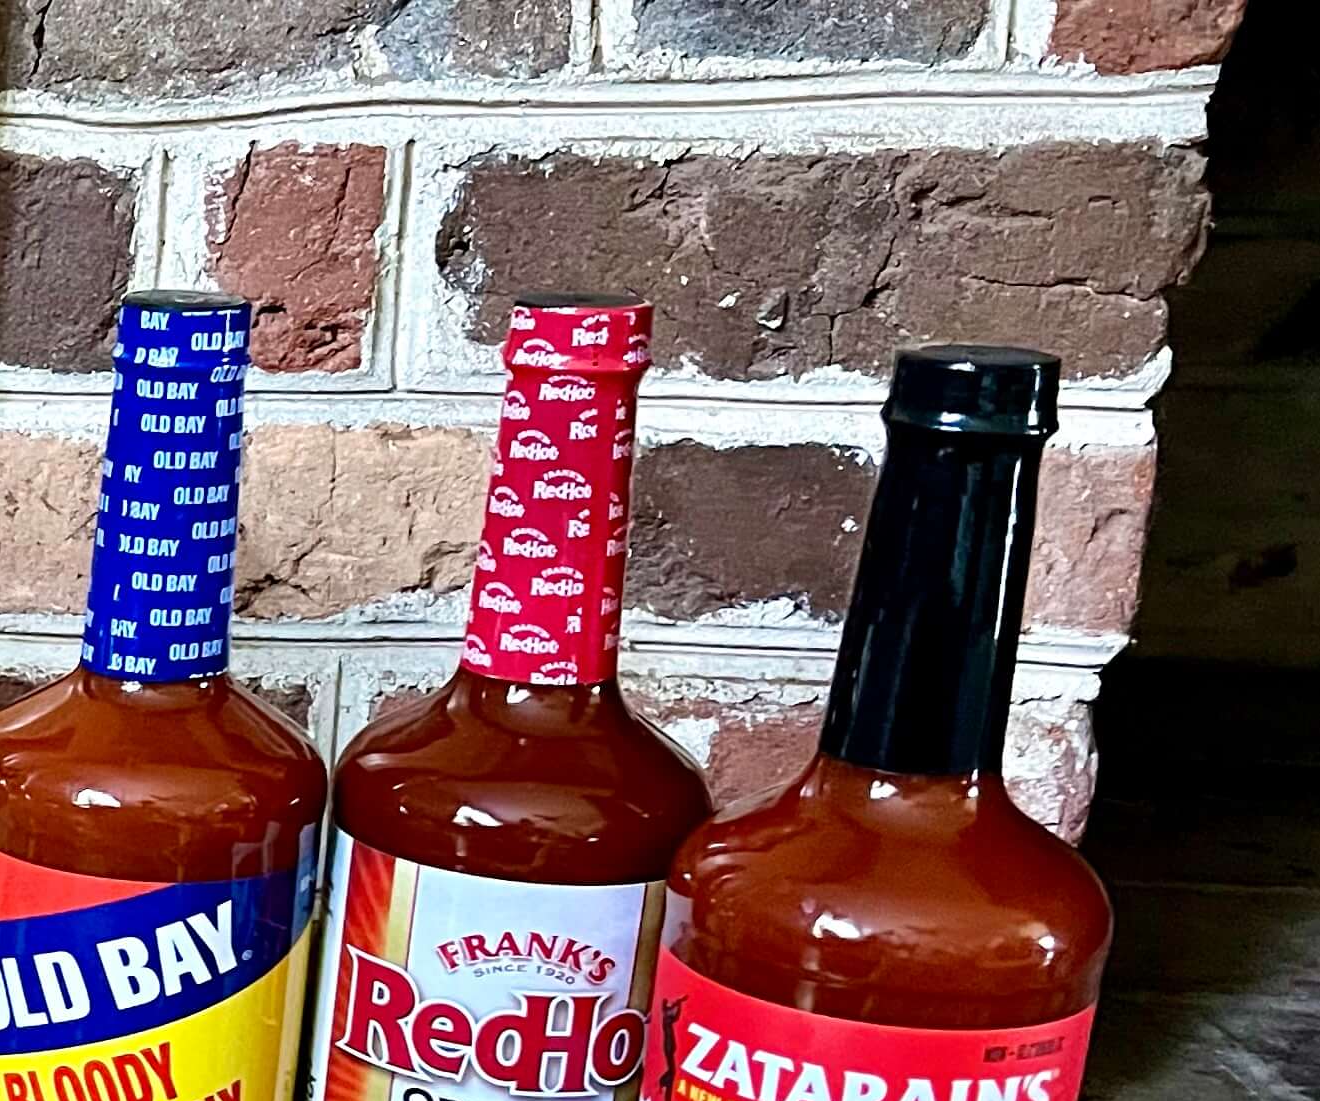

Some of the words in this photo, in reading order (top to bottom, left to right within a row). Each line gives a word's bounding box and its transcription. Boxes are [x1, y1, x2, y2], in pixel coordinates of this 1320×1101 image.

[136, 378, 164, 399] OLD
[167, 382, 199, 400] BAY
[140, 413, 171, 434] OLD
[174, 415, 207, 435] BAY
[153, 450, 186, 469] OLD
[189, 450, 219, 470] BAY
[131, 571, 163, 592] OLD
[166, 574, 197, 592] BAY
[96, 900, 239, 1011] BAY
[437, 931, 616, 983] FRANK'S
[473, 964, 528, 978] SINCE
[536, 965, 575, 985] 1920
[336, 945, 646, 1096] RedHo
[676, 1080, 686, 1096] A
